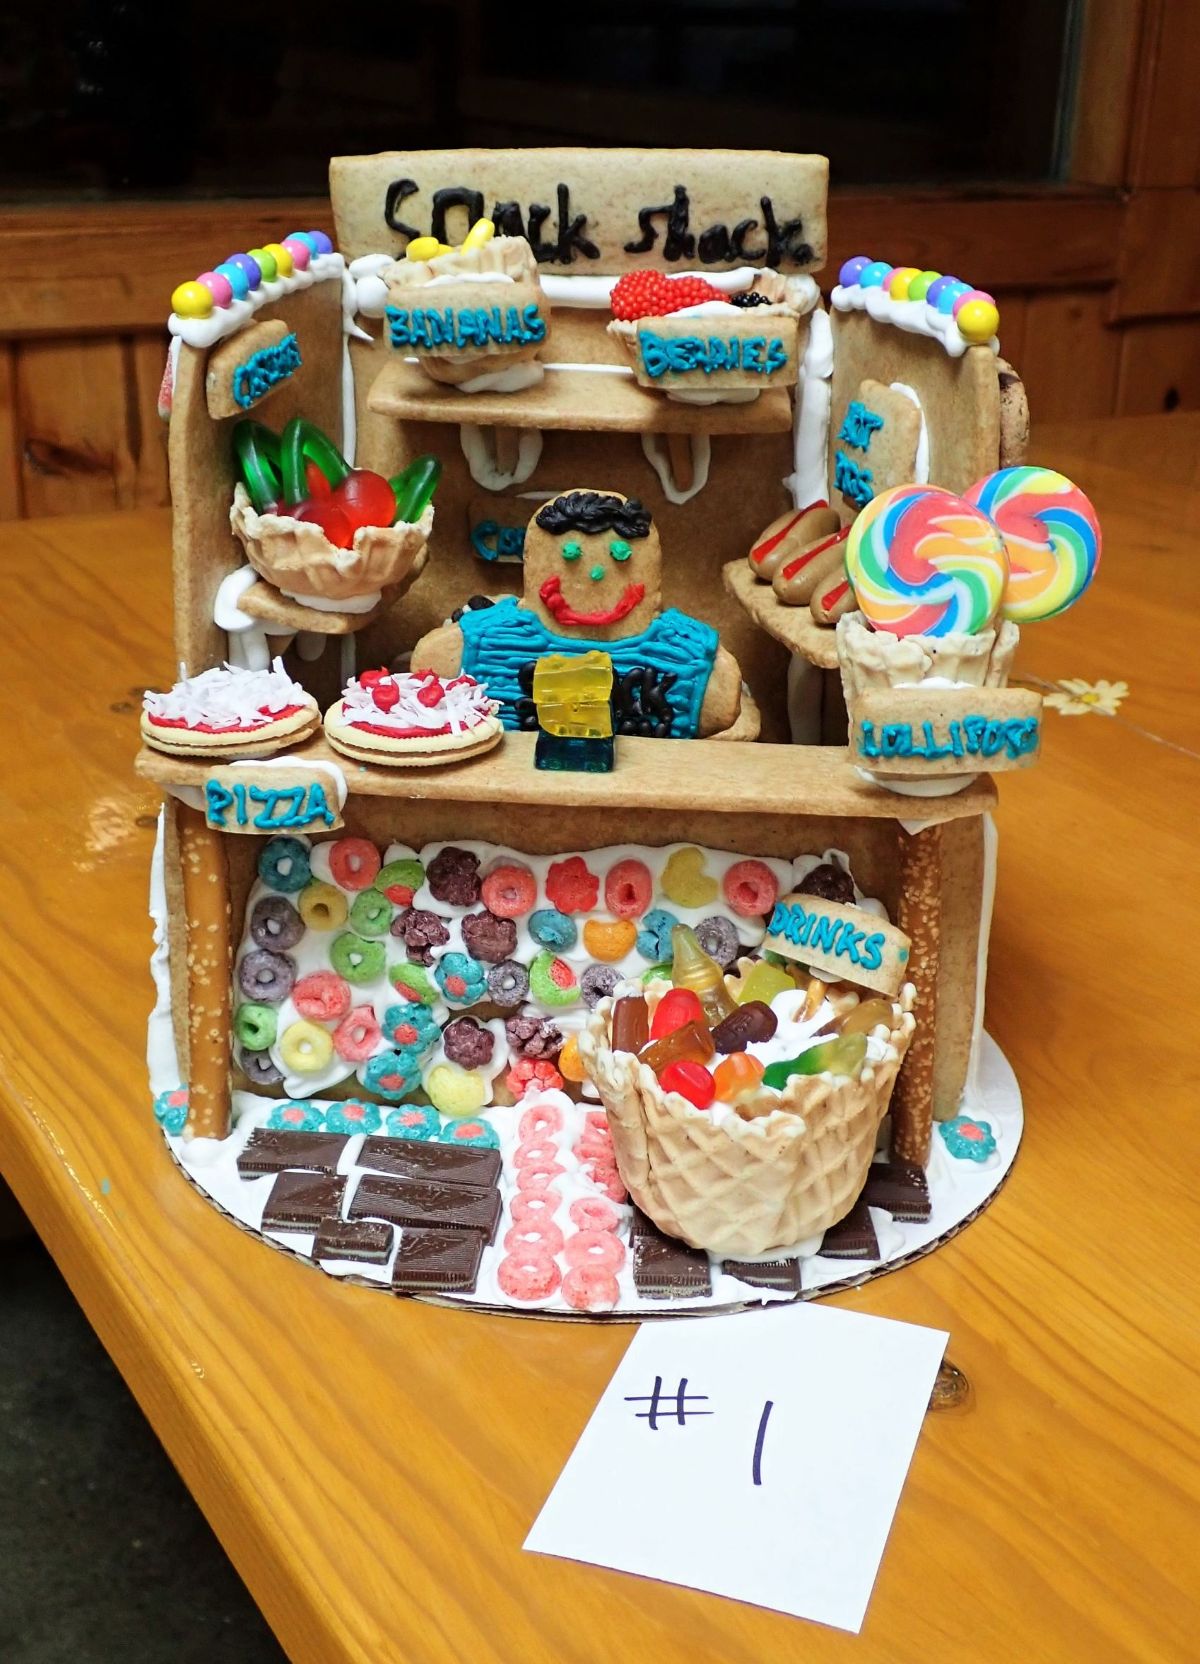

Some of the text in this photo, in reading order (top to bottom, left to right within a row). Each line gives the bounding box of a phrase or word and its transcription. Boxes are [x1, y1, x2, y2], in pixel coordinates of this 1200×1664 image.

[384, 304, 547, 349] BANANAS
[206, 778, 336, 829] PIZZA
[767, 901, 886, 971] DRINKS
